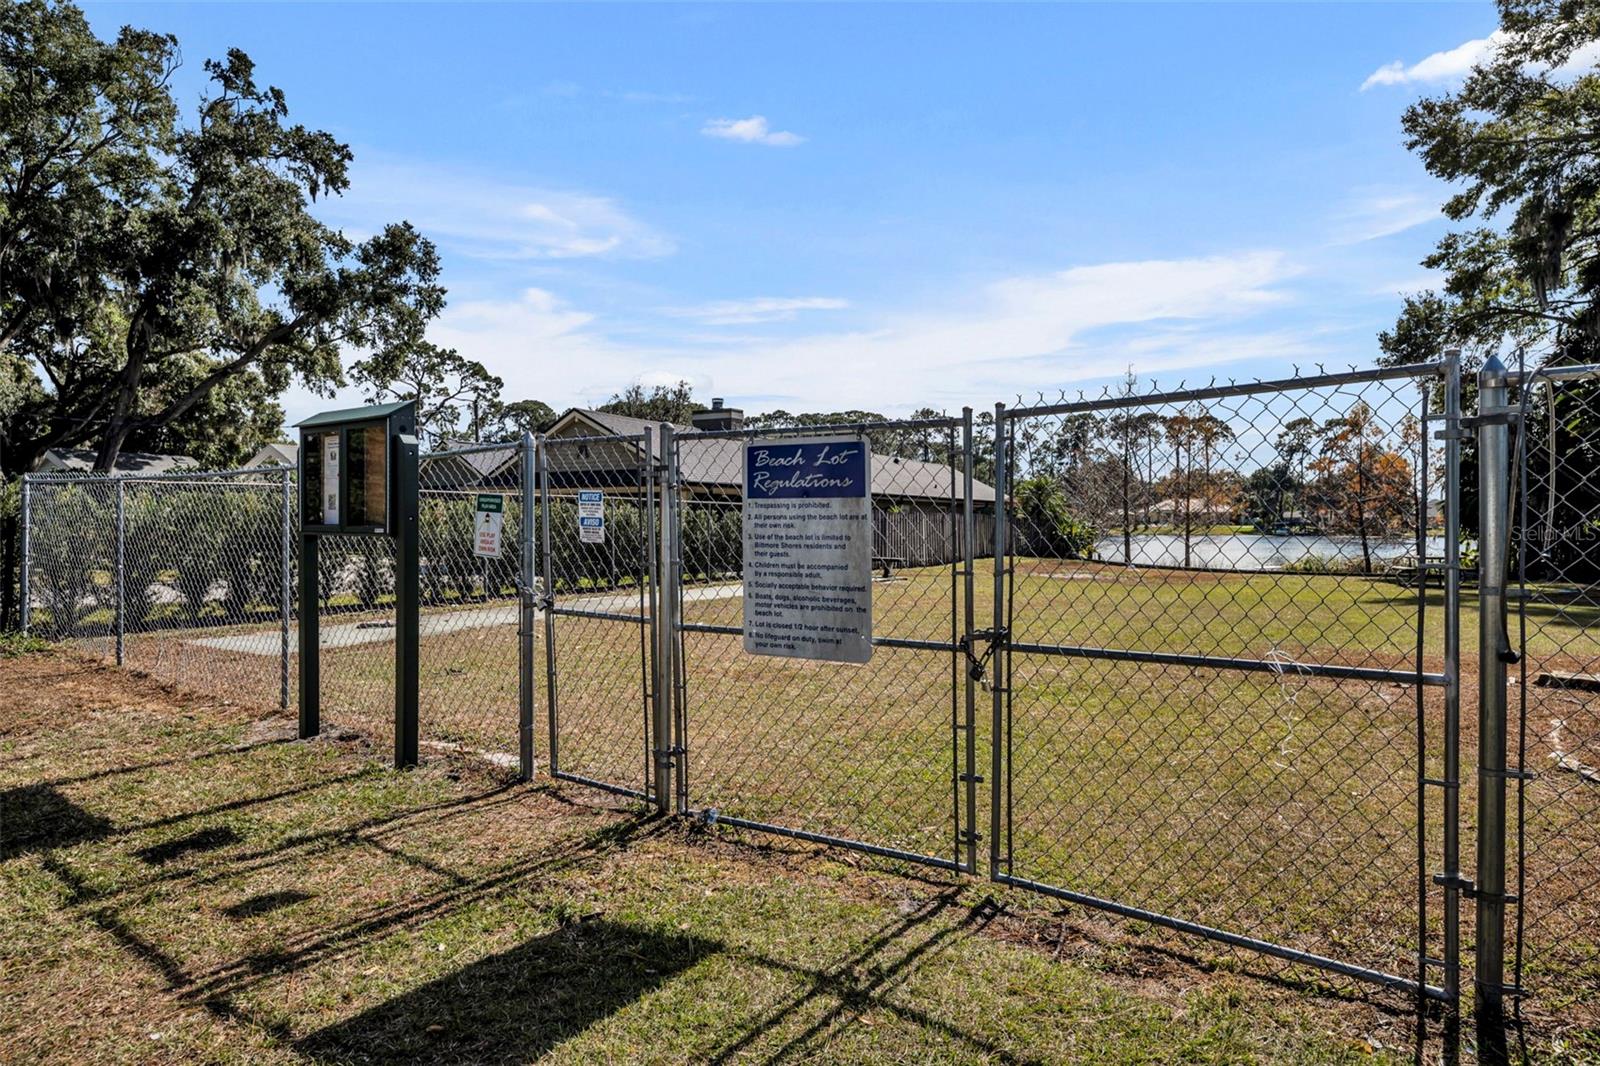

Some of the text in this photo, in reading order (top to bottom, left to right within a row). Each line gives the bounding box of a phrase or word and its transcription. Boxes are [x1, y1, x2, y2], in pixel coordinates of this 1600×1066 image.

[754, 445, 858, 467] Beach Lot
[753, 470, 853, 495] Regulations
[581, 493, 600, 501] NOTICE
[789, 514, 806, 522] using
[755, 581, 778, 589] Socially
